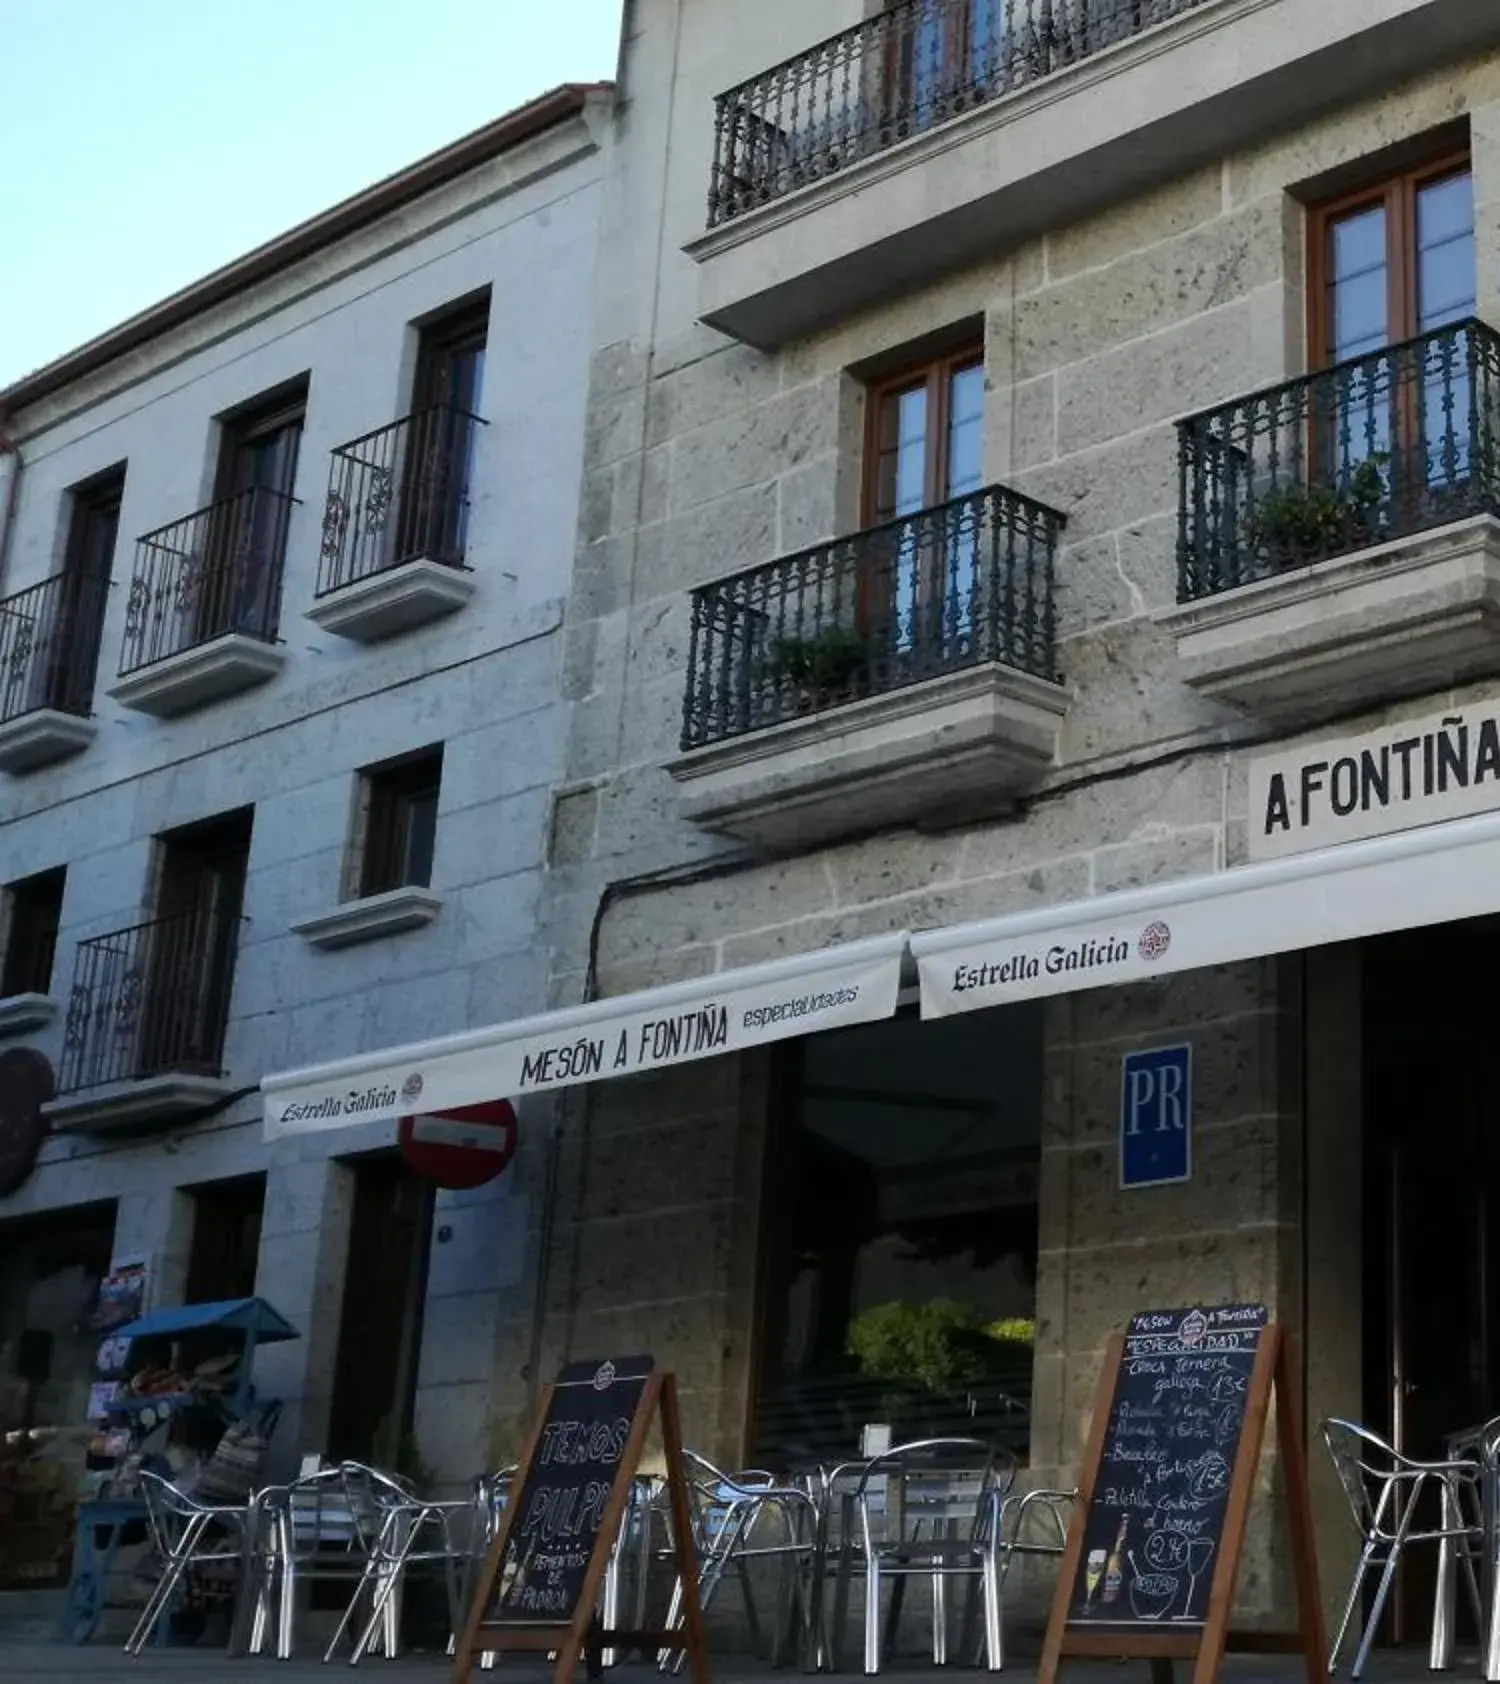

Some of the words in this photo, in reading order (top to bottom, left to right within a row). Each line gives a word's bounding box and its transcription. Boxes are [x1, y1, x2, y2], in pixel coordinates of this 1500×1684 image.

[1264, 772, 1291, 835] A
[952, 955, 1041, 992] Estrella
[1045, 936, 1130, 976] Galicia
[519, 1037, 605, 1087] MESÓN
[613, 1029, 627, 1069] A
[638, 1003, 728, 1063] FONTIÑA
[279, 1096, 342, 1123] Estrella
[343, 1085, 397, 1114] Galicia
[1126, 1065, 1185, 1136] PR
